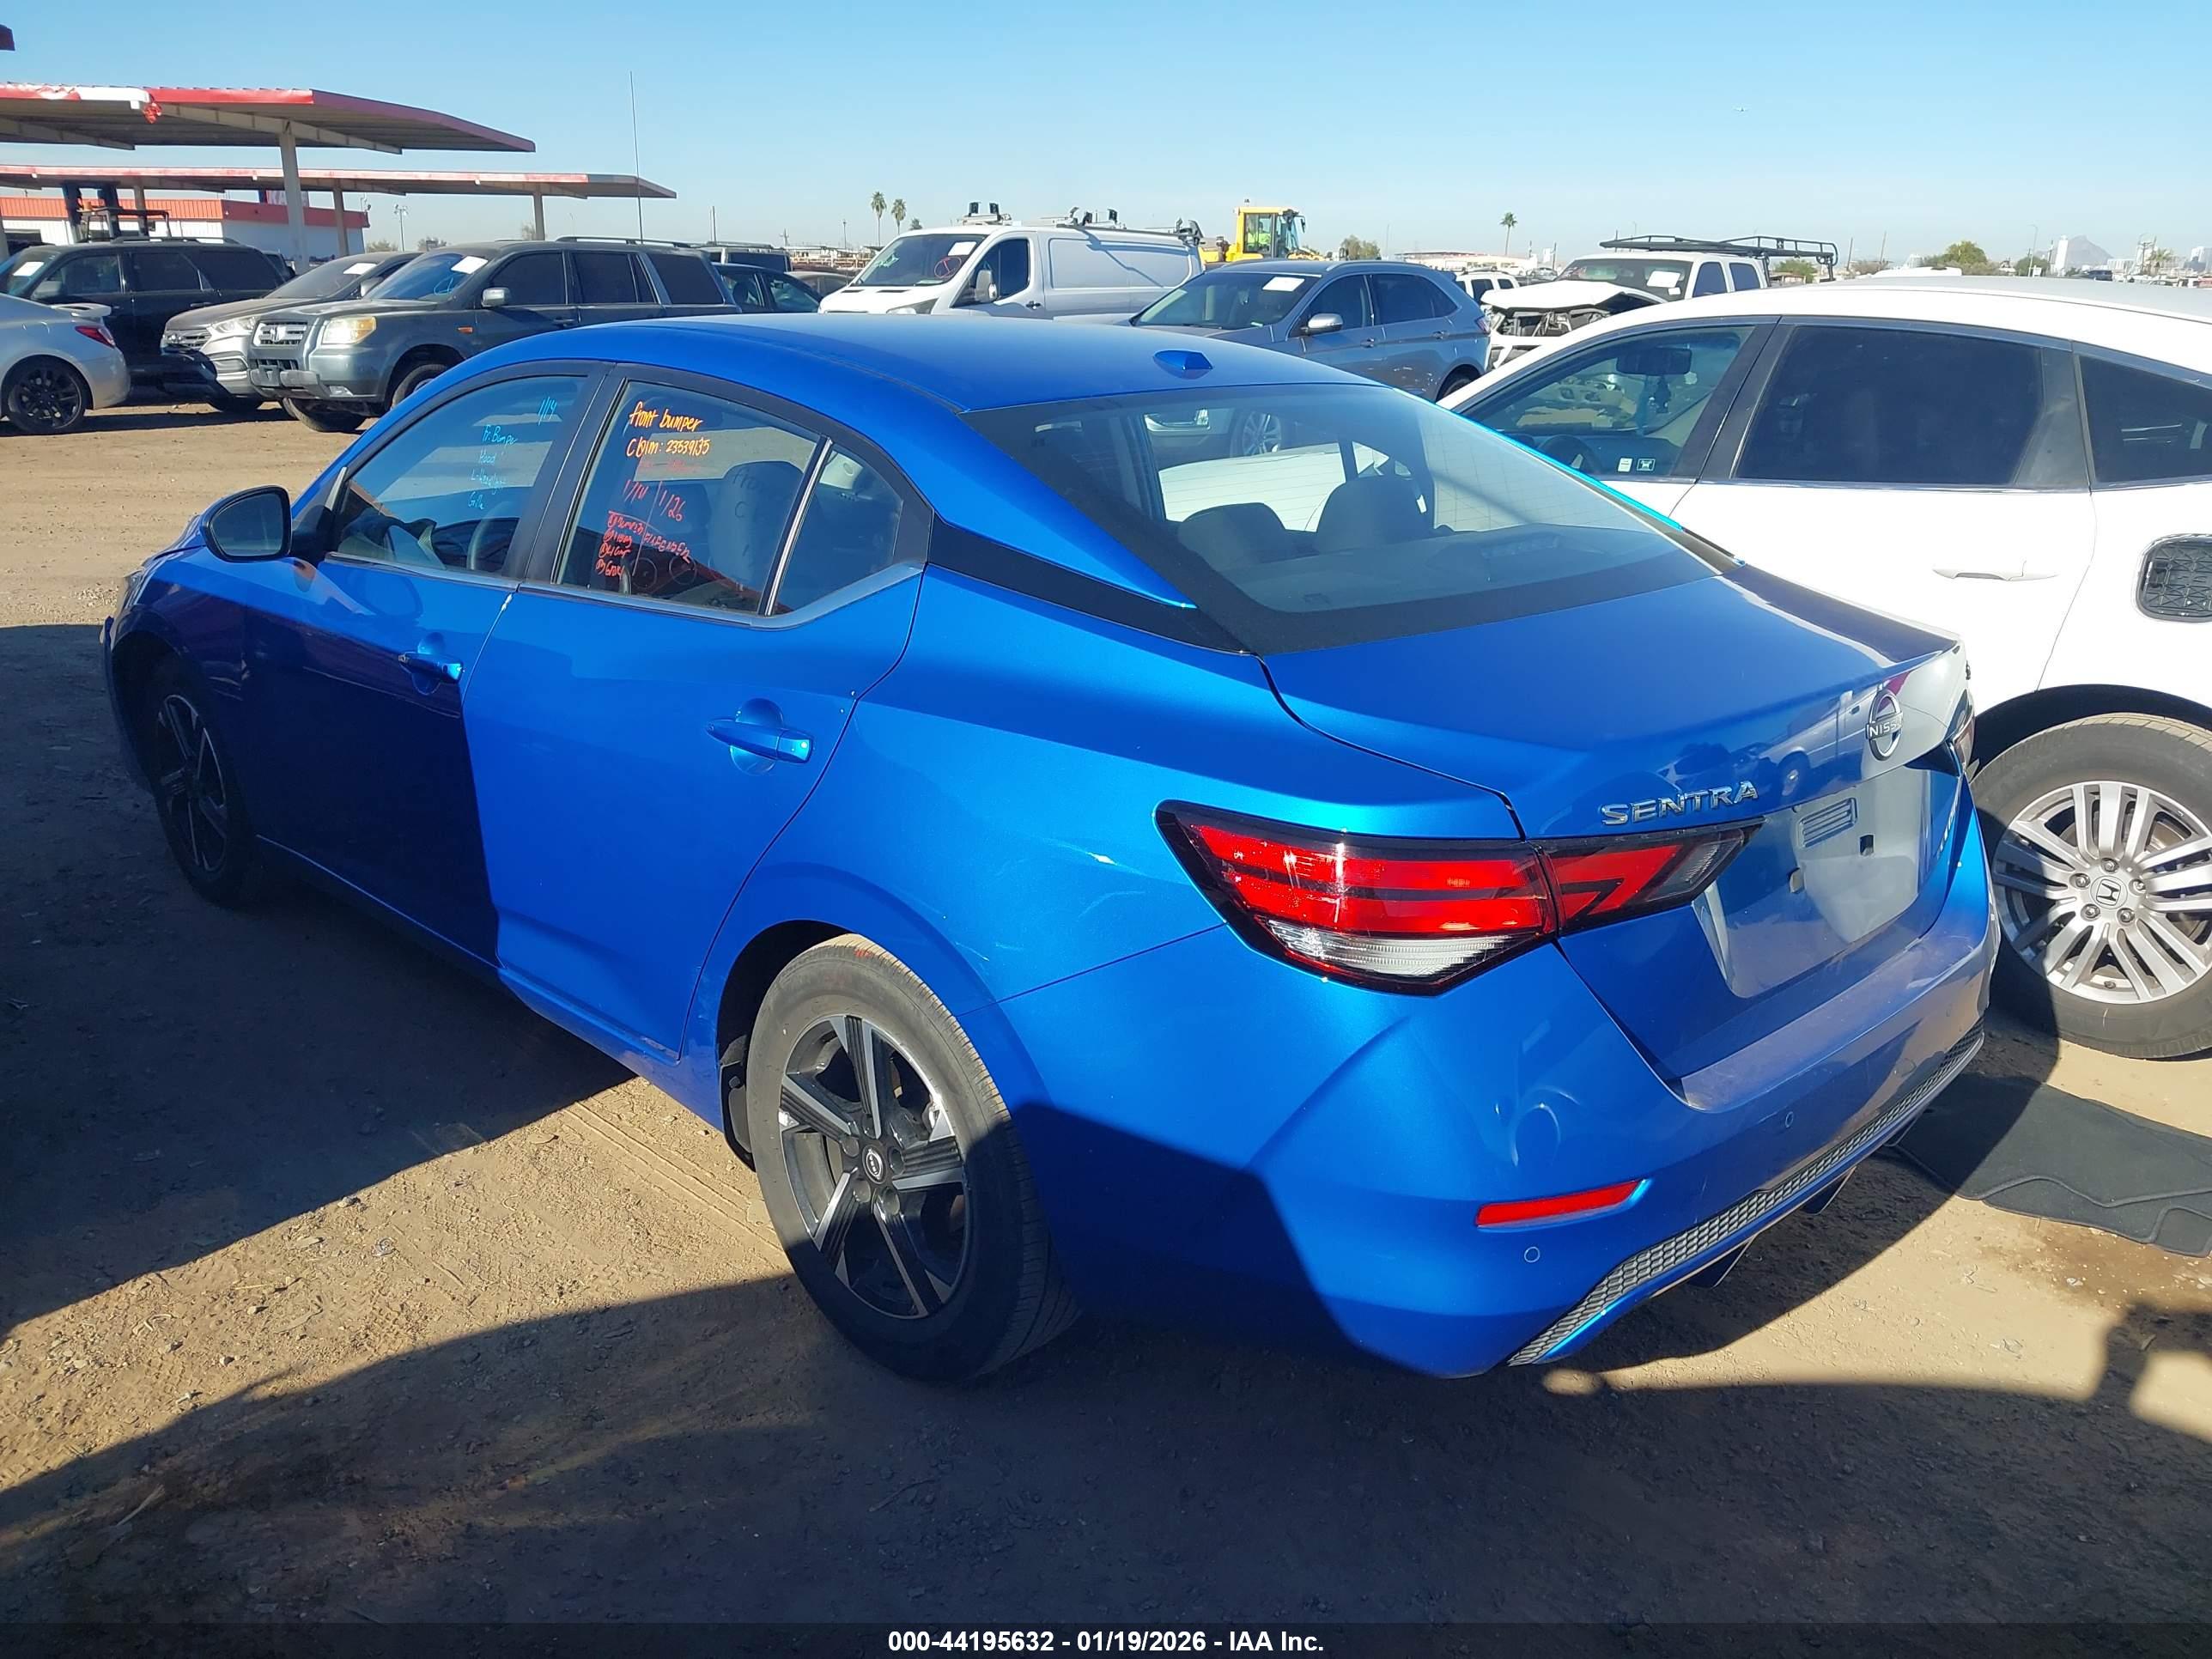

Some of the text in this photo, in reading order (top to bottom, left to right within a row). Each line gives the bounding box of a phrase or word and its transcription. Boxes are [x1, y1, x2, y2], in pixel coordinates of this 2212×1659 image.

[629, 401, 703, 432] front bumper
[1601, 780, 1759, 825] SENTRA
